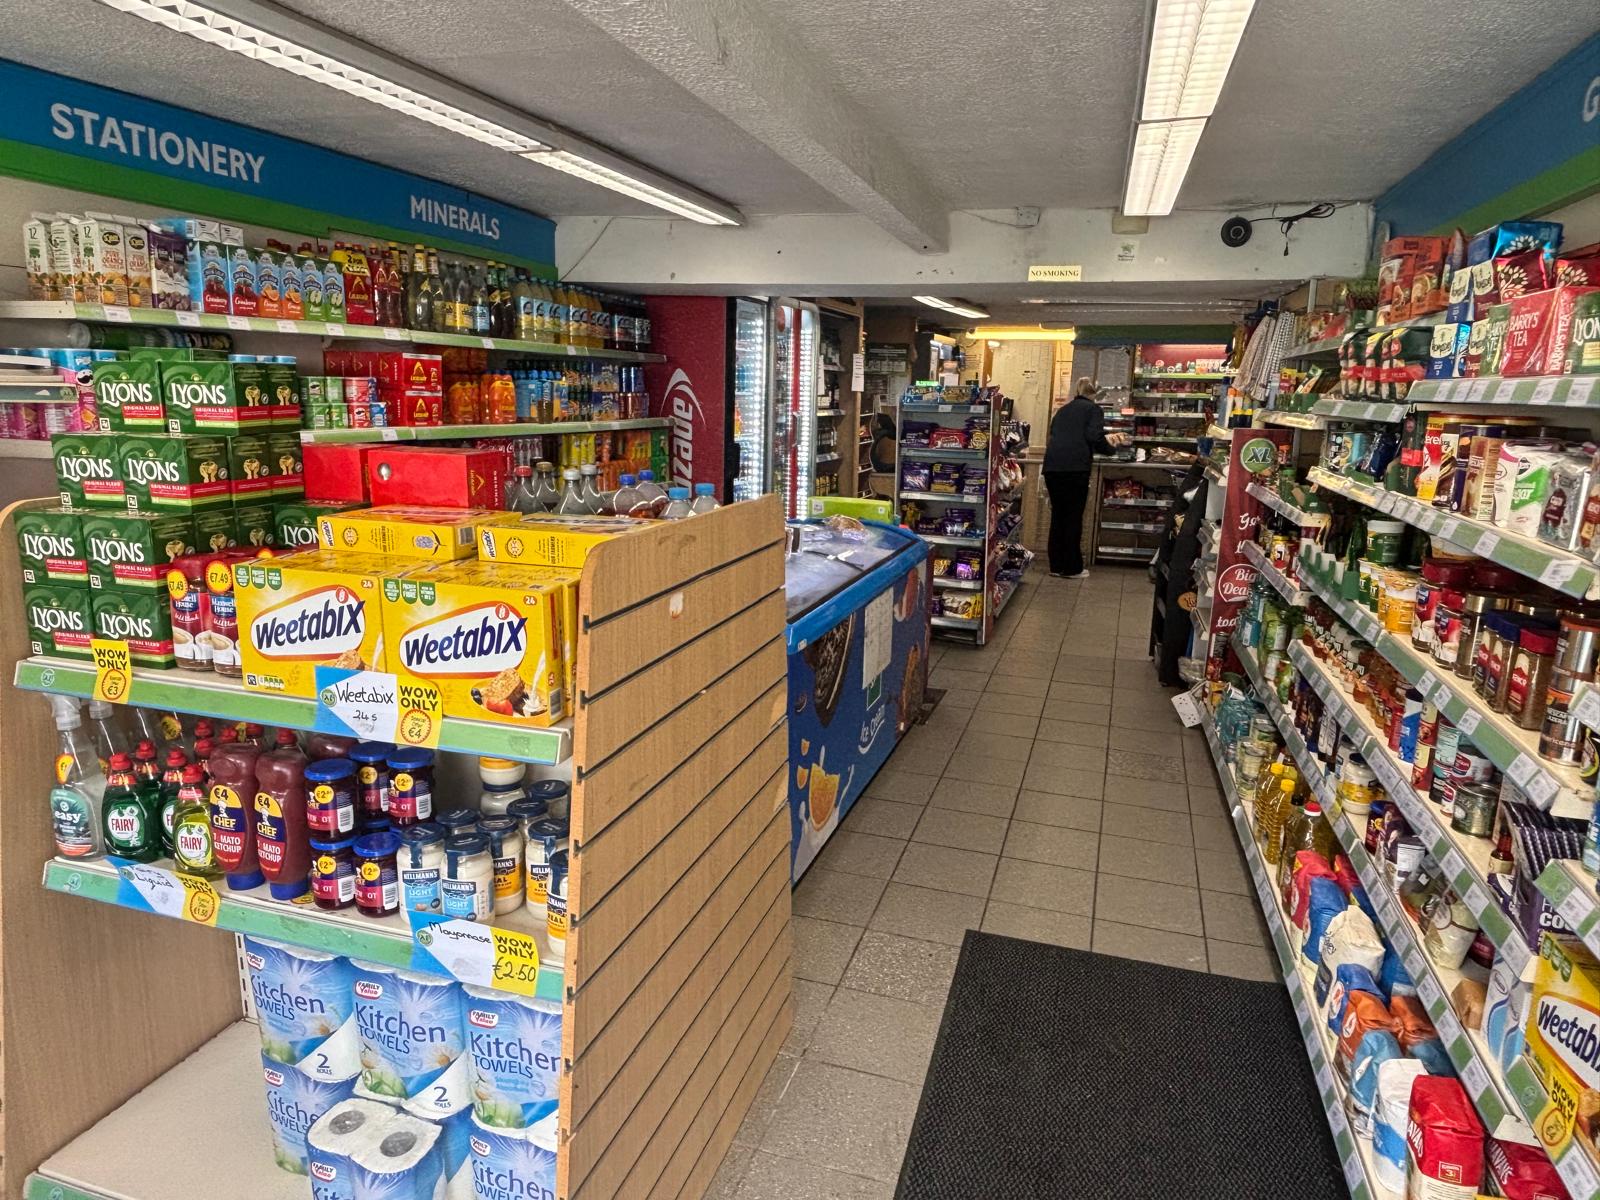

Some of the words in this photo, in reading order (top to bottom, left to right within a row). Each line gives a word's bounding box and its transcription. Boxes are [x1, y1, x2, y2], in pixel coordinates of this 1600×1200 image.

[51, 102, 265, 185] STATIONERY
[410, 195, 500, 240] MINERALS
[1513, 332, 1528, 347] TEA
[1573, 317, 1600, 346] LYON
[101, 380, 153, 407] LYONS
[171, 382, 227, 408] LYONS
[61, 456, 113, 482] LYONS
[128, 458, 180, 484] LYONS
[283, 524, 318, 547] LYON
[24, 533, 75, 557] LYONS
[91, 540, 145, 565] LYONS
[210, 572, 228, 583] €7.49
[33, 606, 84, 632] LYONS
[101, 613, 153, 638] LYONS
[255, 599, 366, 650] Weetabix
[405, 617, 528, 667] Weetabix
[94, 648, 127, 661] WOW
[98, 659, 128, 671] ONLY
[335, 682, 394, 705] Weetabix
[400, 685, 437, 700] WOW
[400, 697, 439, 712] ONLY
[408, 727, 421, 738] €4
[213, 787, 229, 801] €4
[257, 794, 270, 808] €4
[54, 810, 81, 824] easy
[111, 818, 134, 832] FAIRY
[213, 816, 237, 829] CHEF
[257, 822, 278, 837] CHEF
[180, 835, 203, 851] FAIRY
[403, 871, 438, 881] HELLMANN'S
[183, 881, 214, 894] ONLY
[409, 888, 433, 896] LIGHT
[442, 881, 474, 892] HELLMANN'S
[446, 900, 468, 908] LIGHT
[495, 934, 533, 950] WOW
[497, 945, 535, 960] ONLY
[492, 957, 536, 982] €2.50
[357, 981, 380, 991] FAMILY
[360, 987, 378, 996] Value
[255, 995, 295, 1021] OWELS
[472, 1011, 496, 1020] FAMILY
[355, 1002, 446, 1043] Kitchen
[476, 1016, 494, 1025] Value
[359, 1026, 410, 1055] TOWELS
[1538, 1001, 1600, 1073] Weetabi
[317, 1053, 331, 1069] 2
[472, 1053, 534, 1079] TOWELS
[433, 1085, 448, 1103] 2
[1552, 1077, 1576, 1112] WOW
[267, 1089, 321, 1123] Kitche
[271, 1110, 309, 1135] OWELS
[312, 1163, 333, 1173] FAMILY
